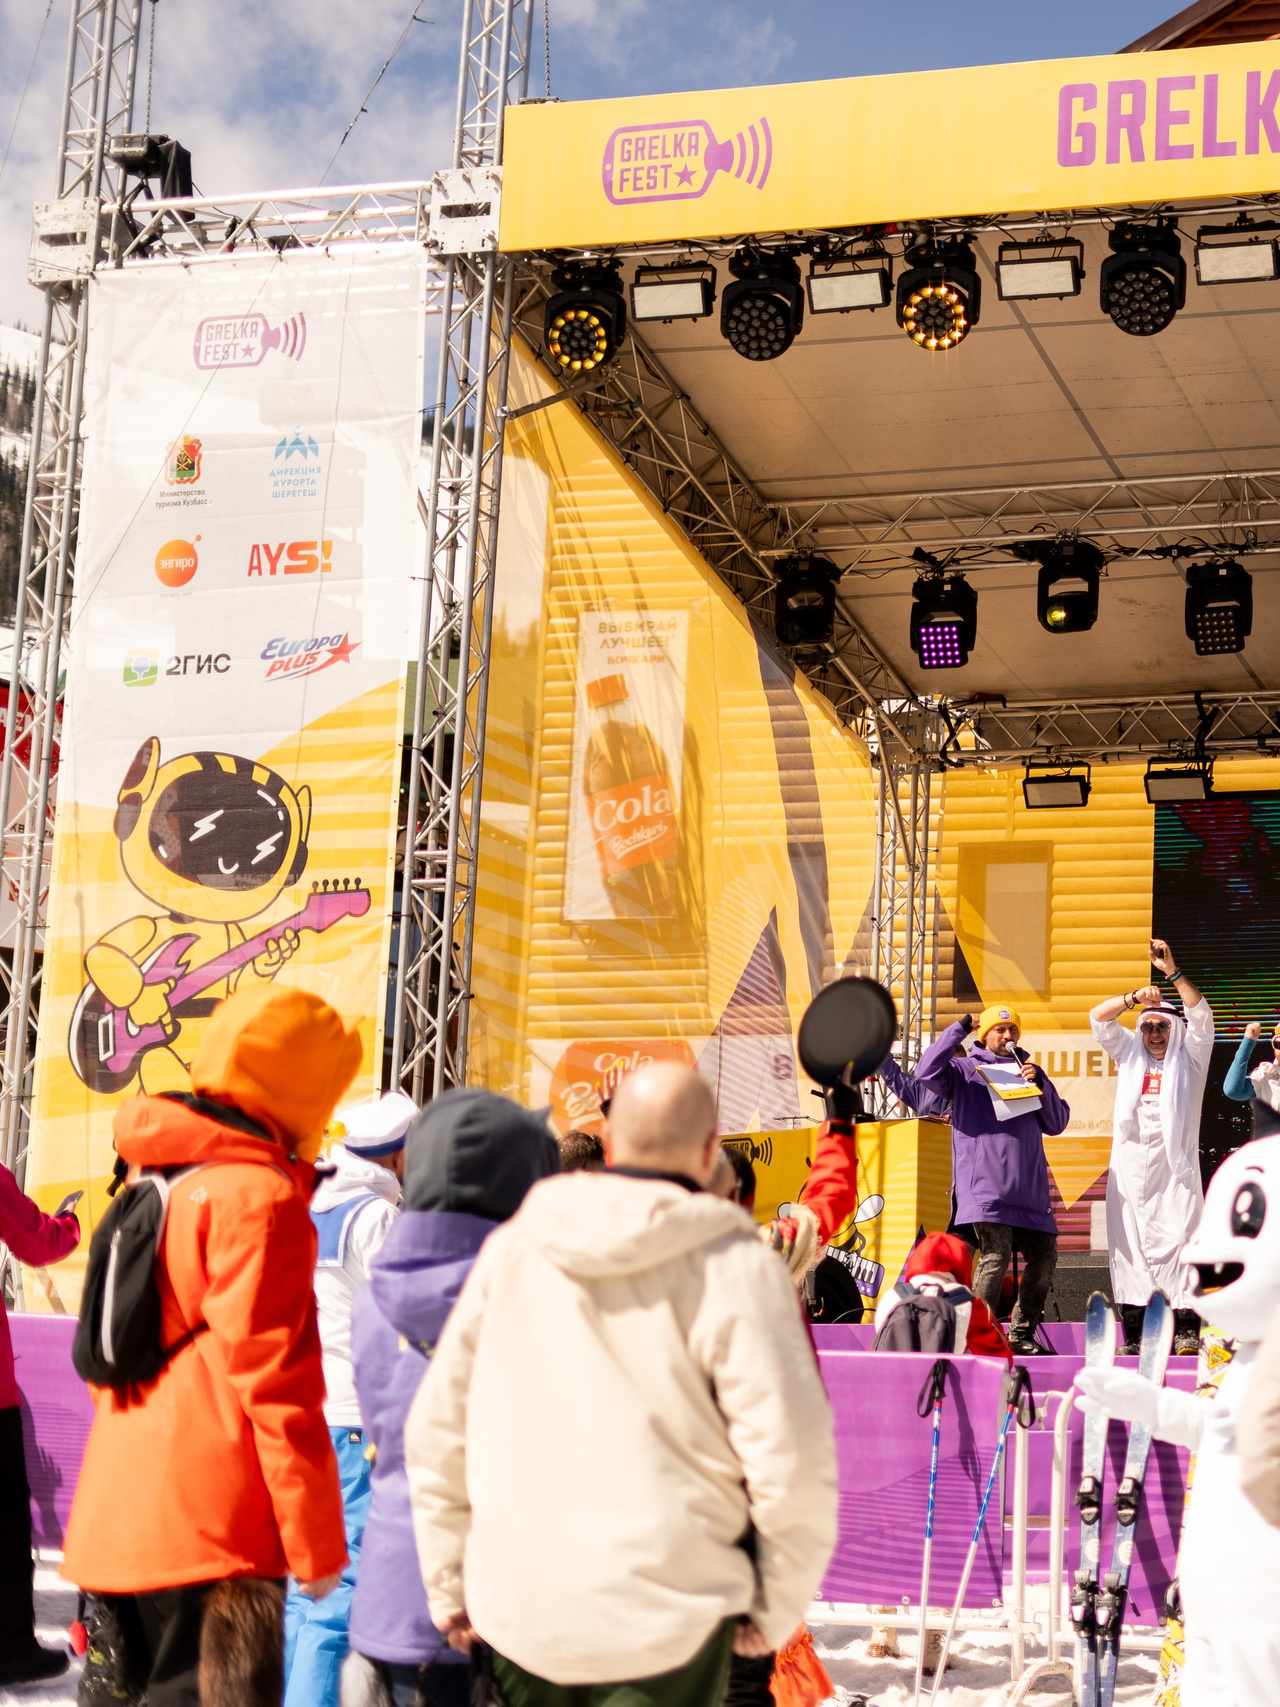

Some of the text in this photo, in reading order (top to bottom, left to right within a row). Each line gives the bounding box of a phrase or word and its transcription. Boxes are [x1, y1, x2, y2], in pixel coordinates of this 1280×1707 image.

[620, 132, 700, 163] GRELKA
[619, 163, 673, 193] FEST
[205, 321, 259, 342] GRELKA
[203, 342, 240, 362] FEST
[269, 466, 322, 478] ДИРЕКЦИЯ
[273, 478, 316, 487] КУРОРТА
[159, 489, 206, 498] Министерство
[272, 488, 317, 498] ШЕРЕГЕШ
[155, 500, 182, 509] туризма
[159, 556, 195, 572] энгиро
[247, 540, 333, 577] AYS!
[597, 616, 678, 634] ВЫБИРАЙ
[166, 653, 232, 676] 2ГИС
[607, 654, 666, 665] БОЧКАРИ
[593, 785, 679, 832] Cola
